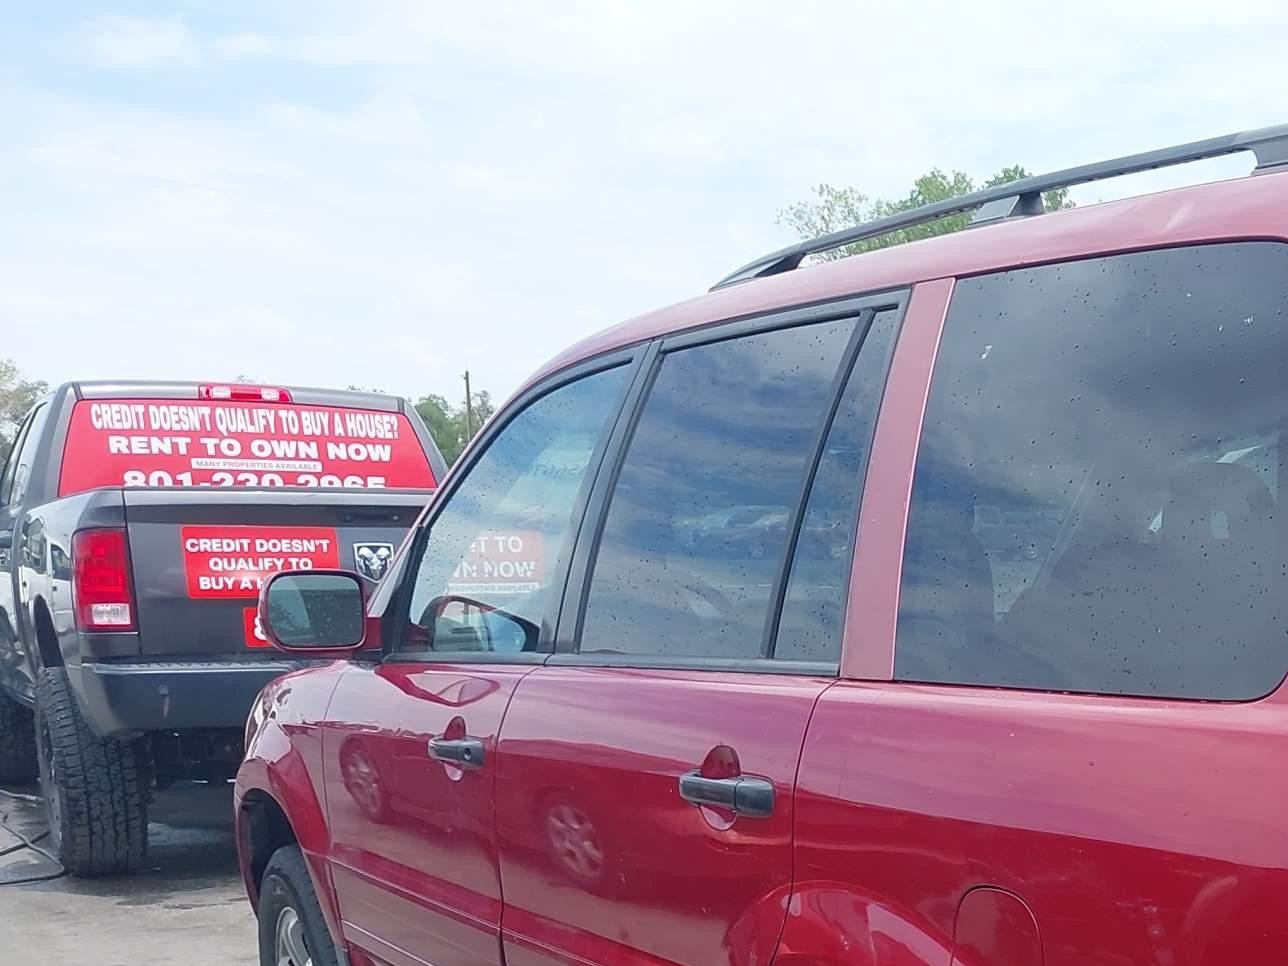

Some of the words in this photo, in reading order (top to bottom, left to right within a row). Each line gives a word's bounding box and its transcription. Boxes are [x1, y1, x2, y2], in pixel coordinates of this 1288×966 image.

[90, 403, 145, 431] CREDIT
[148, 404, 212, 432] DOESN'T
[215, 406, 276, 437] QUALIFY
[278, 409, 300, 436] TO
[301, 410, 330, 437] BUY
[333, 412, 345, 437] A
[345, 413, 399, 440] HOUSE?
[108, 435, 192, 455] RENT
[200, 437, 242, 457] TO
[250, 439, 319, 460] OWN
[326, 442, 392, 463] NOW
[195, 460, 221, 468] MANY
[222, 461, 274, 469] PROPERTIES
[275, 462, 318, 471] AVAILABLE
[185, 538, 251, 553] CREDIT
[255, 539, 330, 553] DOESN'T
[493, 535, 523, 553] TO
[208, 557, 287, 572] QUALIFY
[288, 557, 313, 570] TO
[483, 561, 536, 578] NOW
[198, 576, 238, 591] BUY
[239, 576, 253, 590] A
